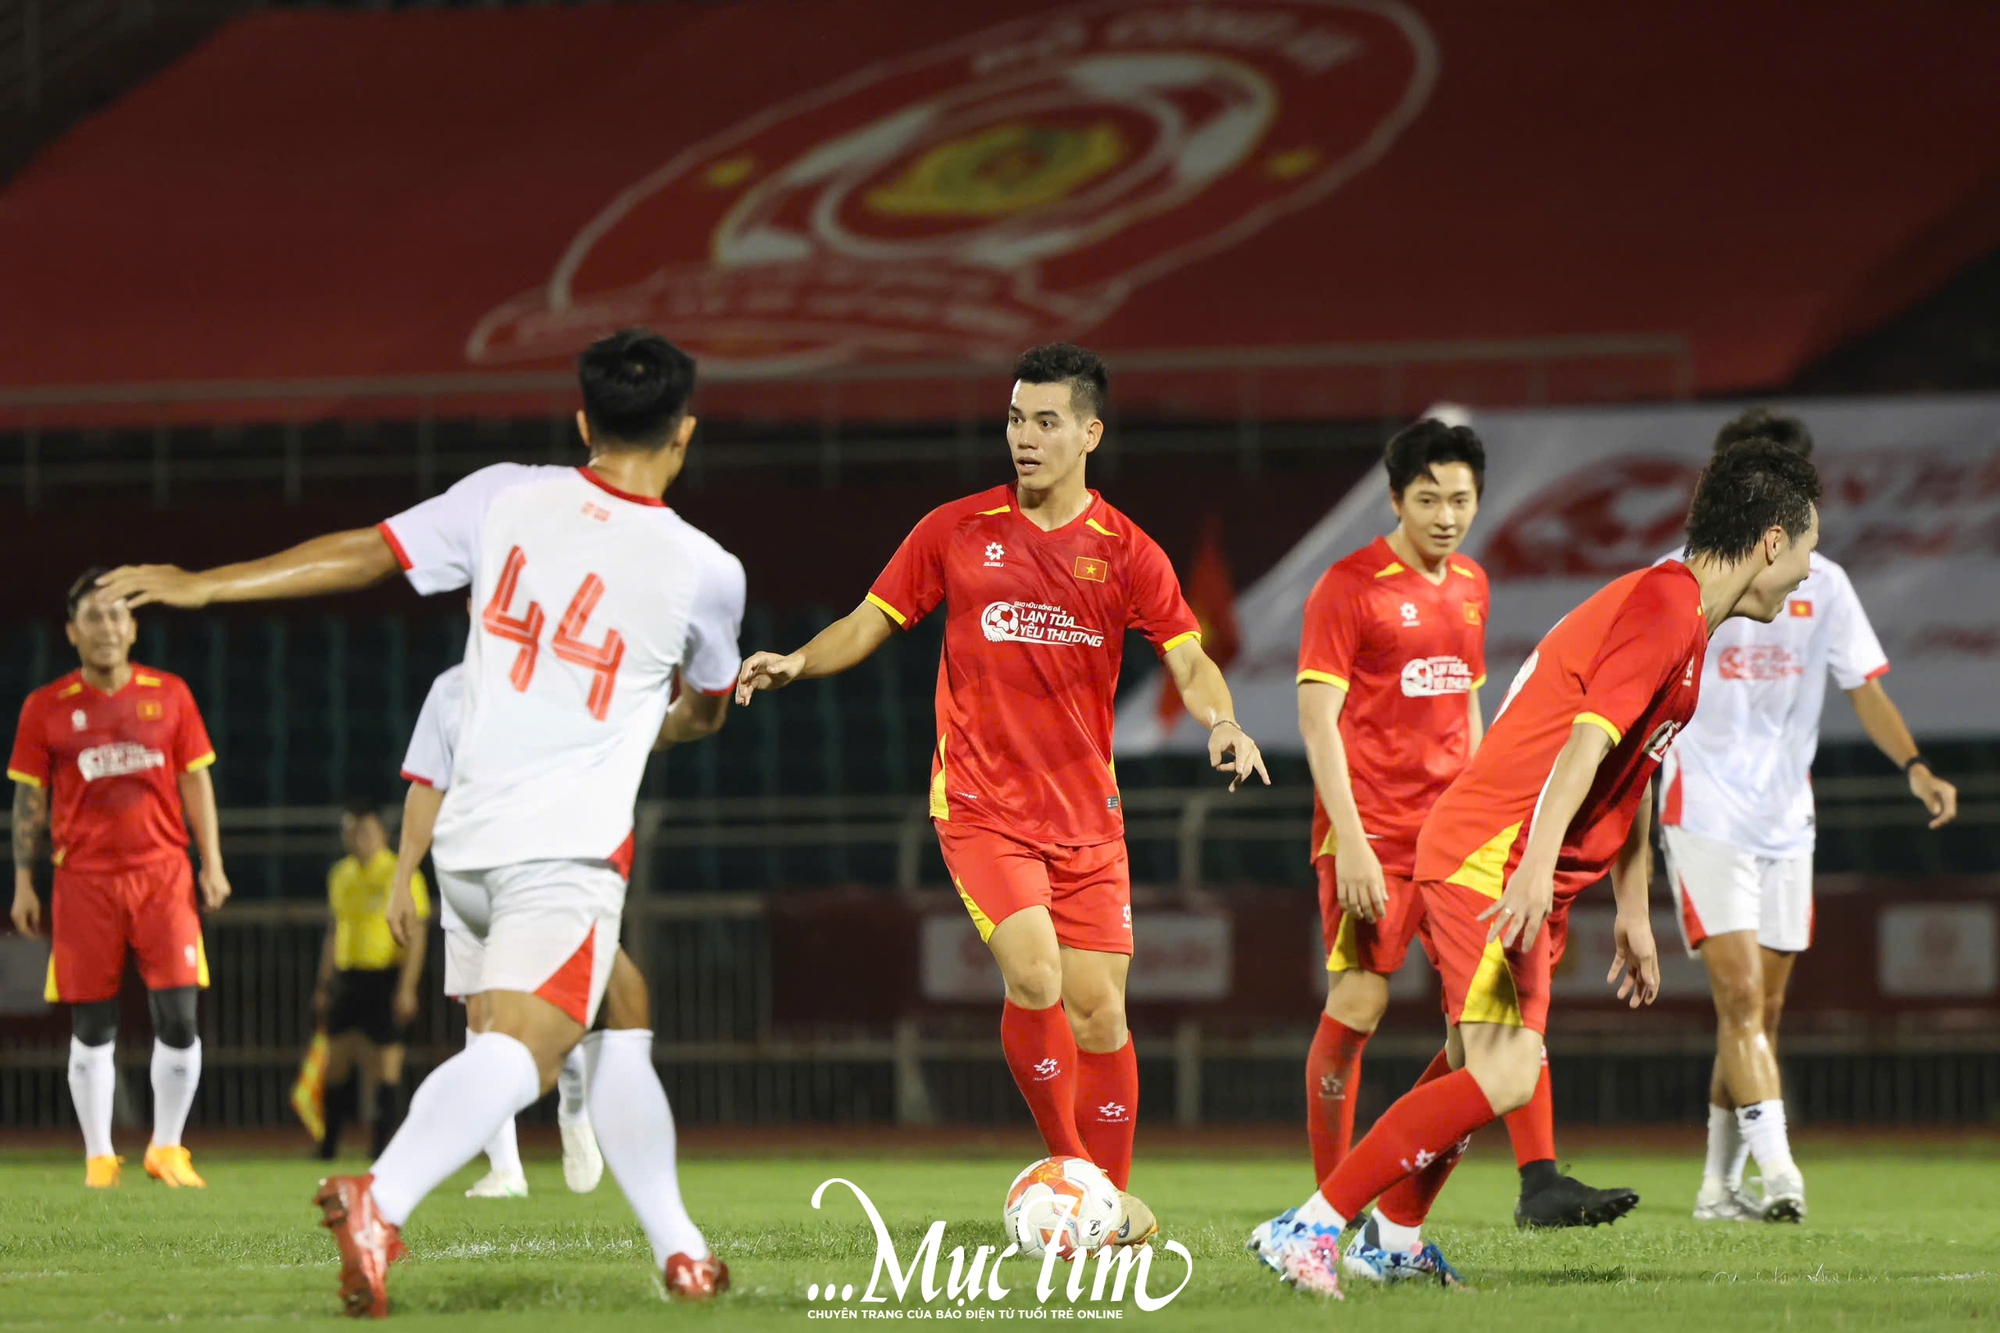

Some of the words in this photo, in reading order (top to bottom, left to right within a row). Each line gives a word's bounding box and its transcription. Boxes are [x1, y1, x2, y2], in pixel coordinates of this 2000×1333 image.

[1020, 609, 1050, 624] LAN
[1049, 610, 1075, 628] TỎA
[482, 544, 626, 722] 44
[1020, 623, 1047, 639] YÊU
[1047, 628, 1104, 648] THƯƠNG
